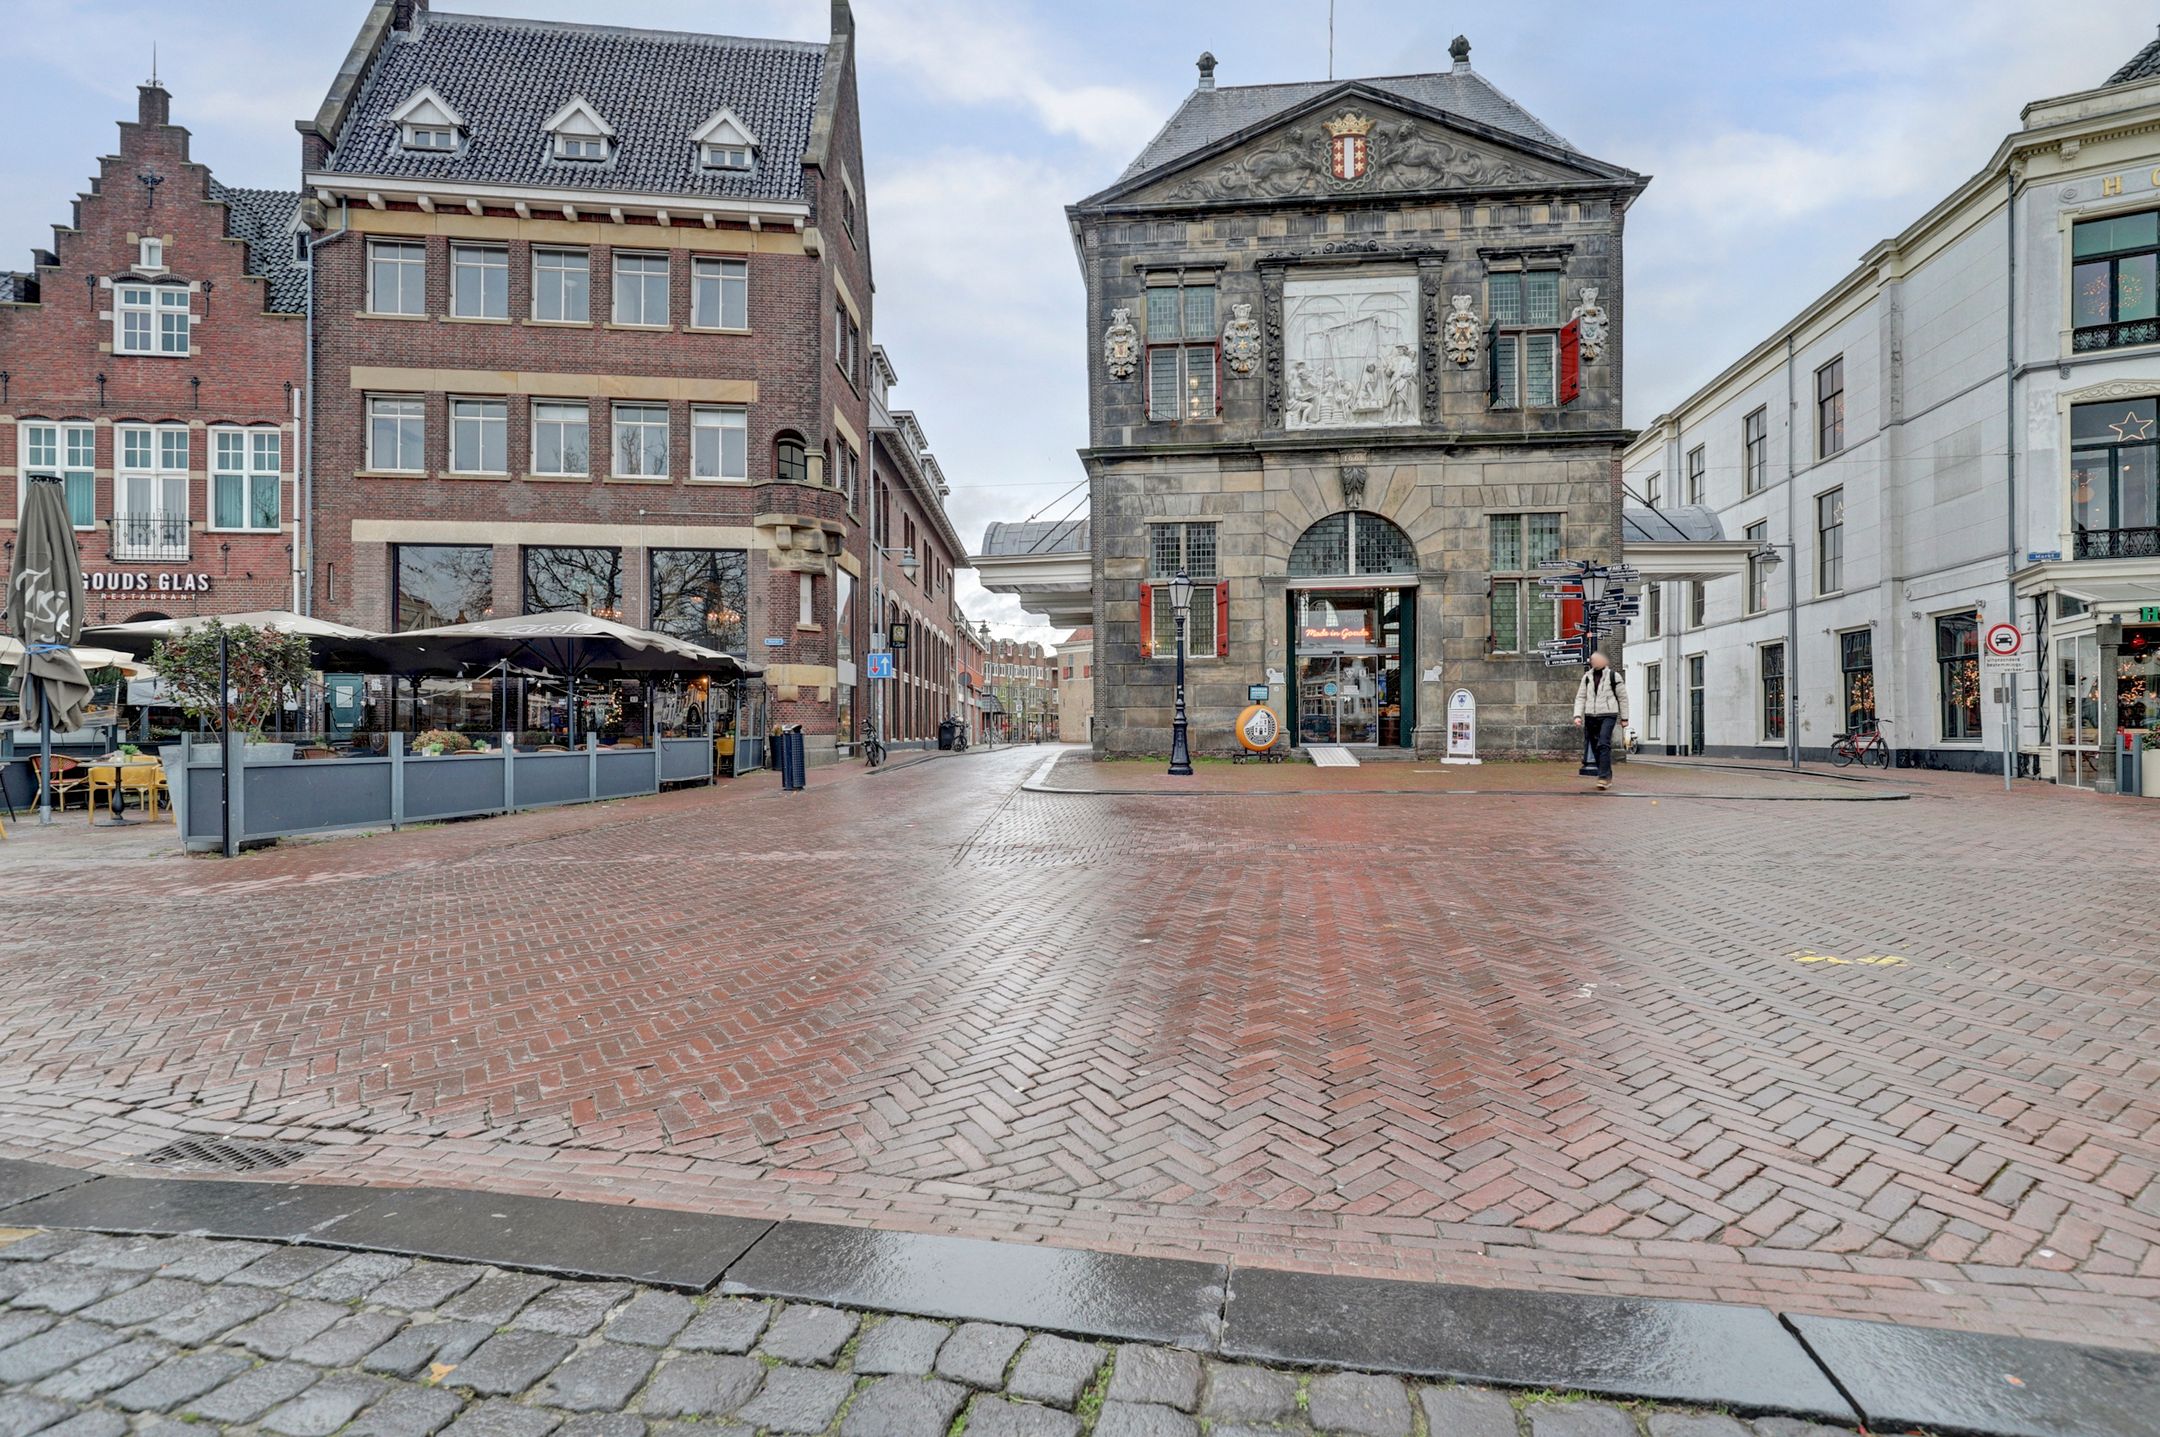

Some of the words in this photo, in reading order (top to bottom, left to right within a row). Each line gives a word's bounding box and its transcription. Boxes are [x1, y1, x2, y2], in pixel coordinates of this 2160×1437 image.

[81, 573, 149, 591] GOUDS
[100, 593, 196, 601] RESTAURANT
[1305, 628, 1328, 637] Made
[1329, 629, 1339, 637] in
[1341, 628, 1369, 640] Gouda
